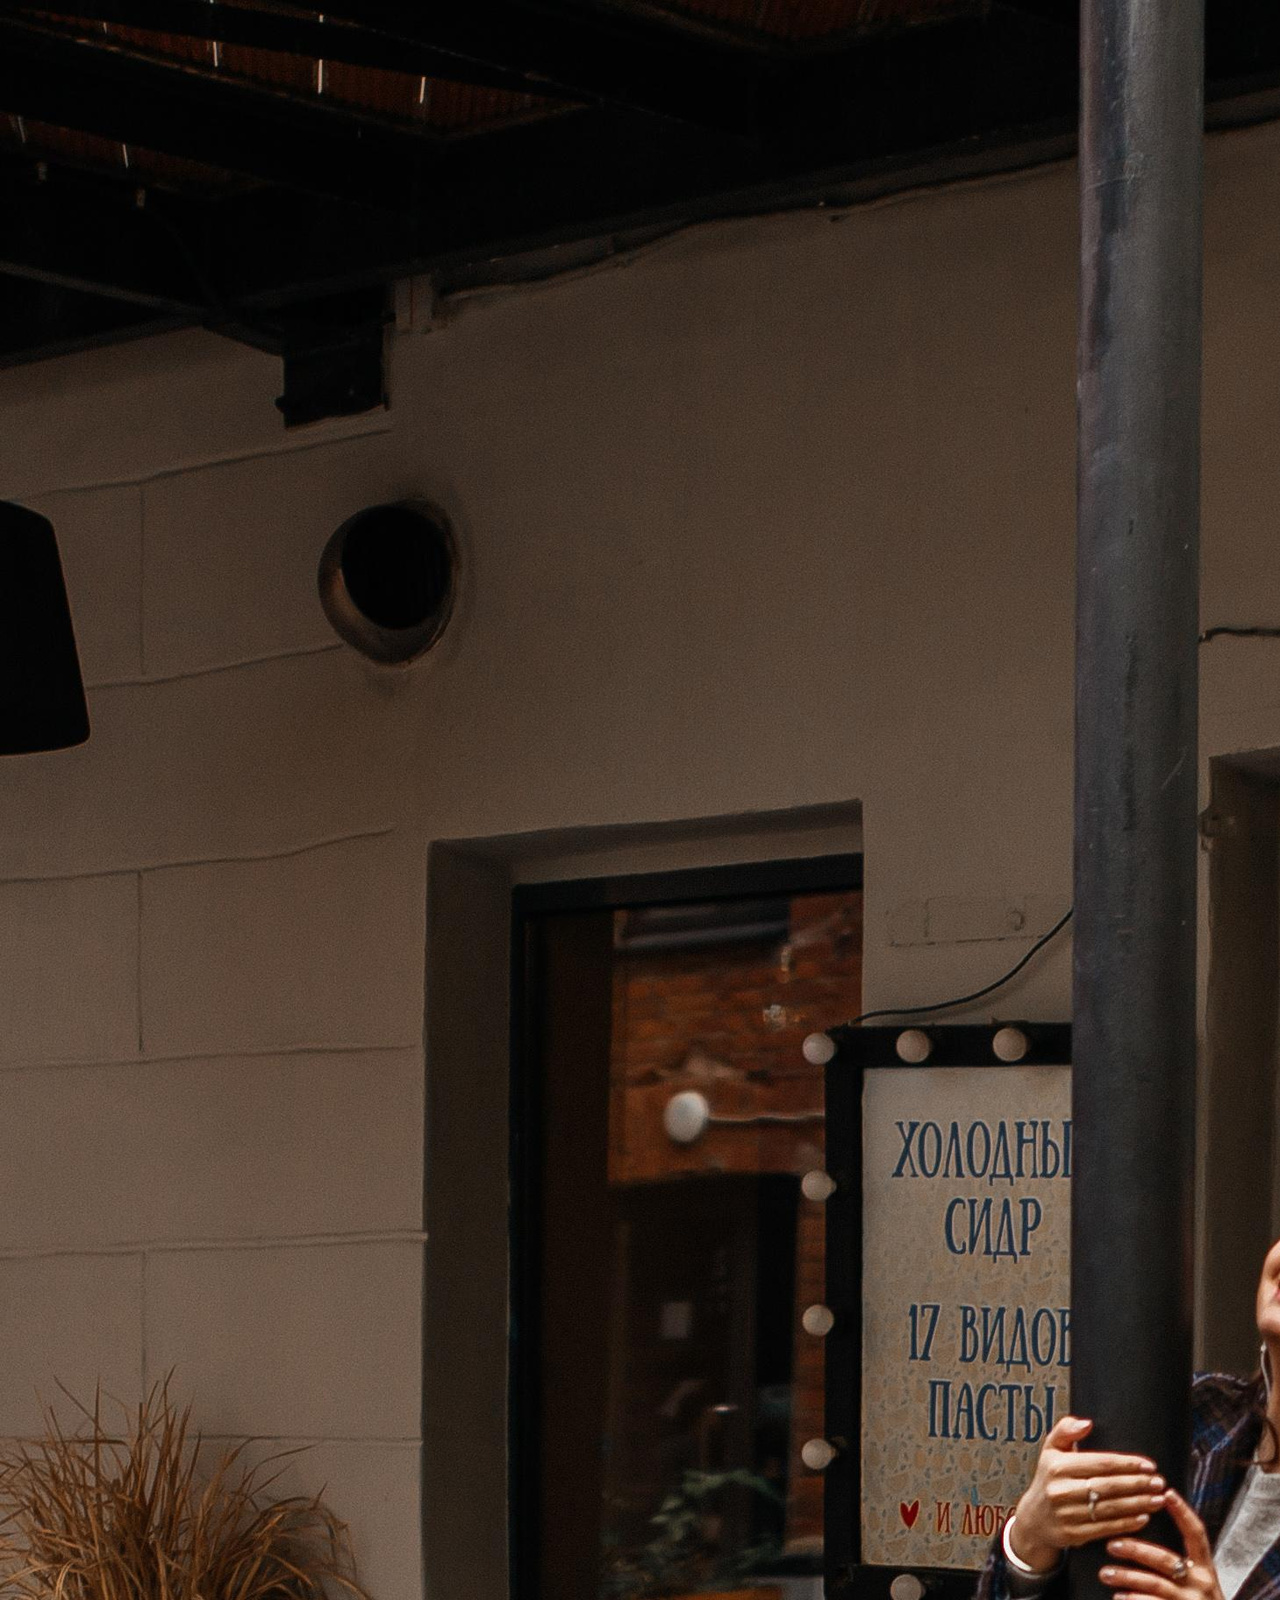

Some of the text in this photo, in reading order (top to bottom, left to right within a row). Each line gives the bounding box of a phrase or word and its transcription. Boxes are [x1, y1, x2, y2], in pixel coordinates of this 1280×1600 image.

[891, 1120, 1072, 1186] ХОЛОДНЫ
[944, 1197, 1042, 1263] СИДР
[907, 1304, 941, 1362] 17
[927, 1380, 1055, 1442] ПАСТЫ
[936, 1502, 951, 1534] И
